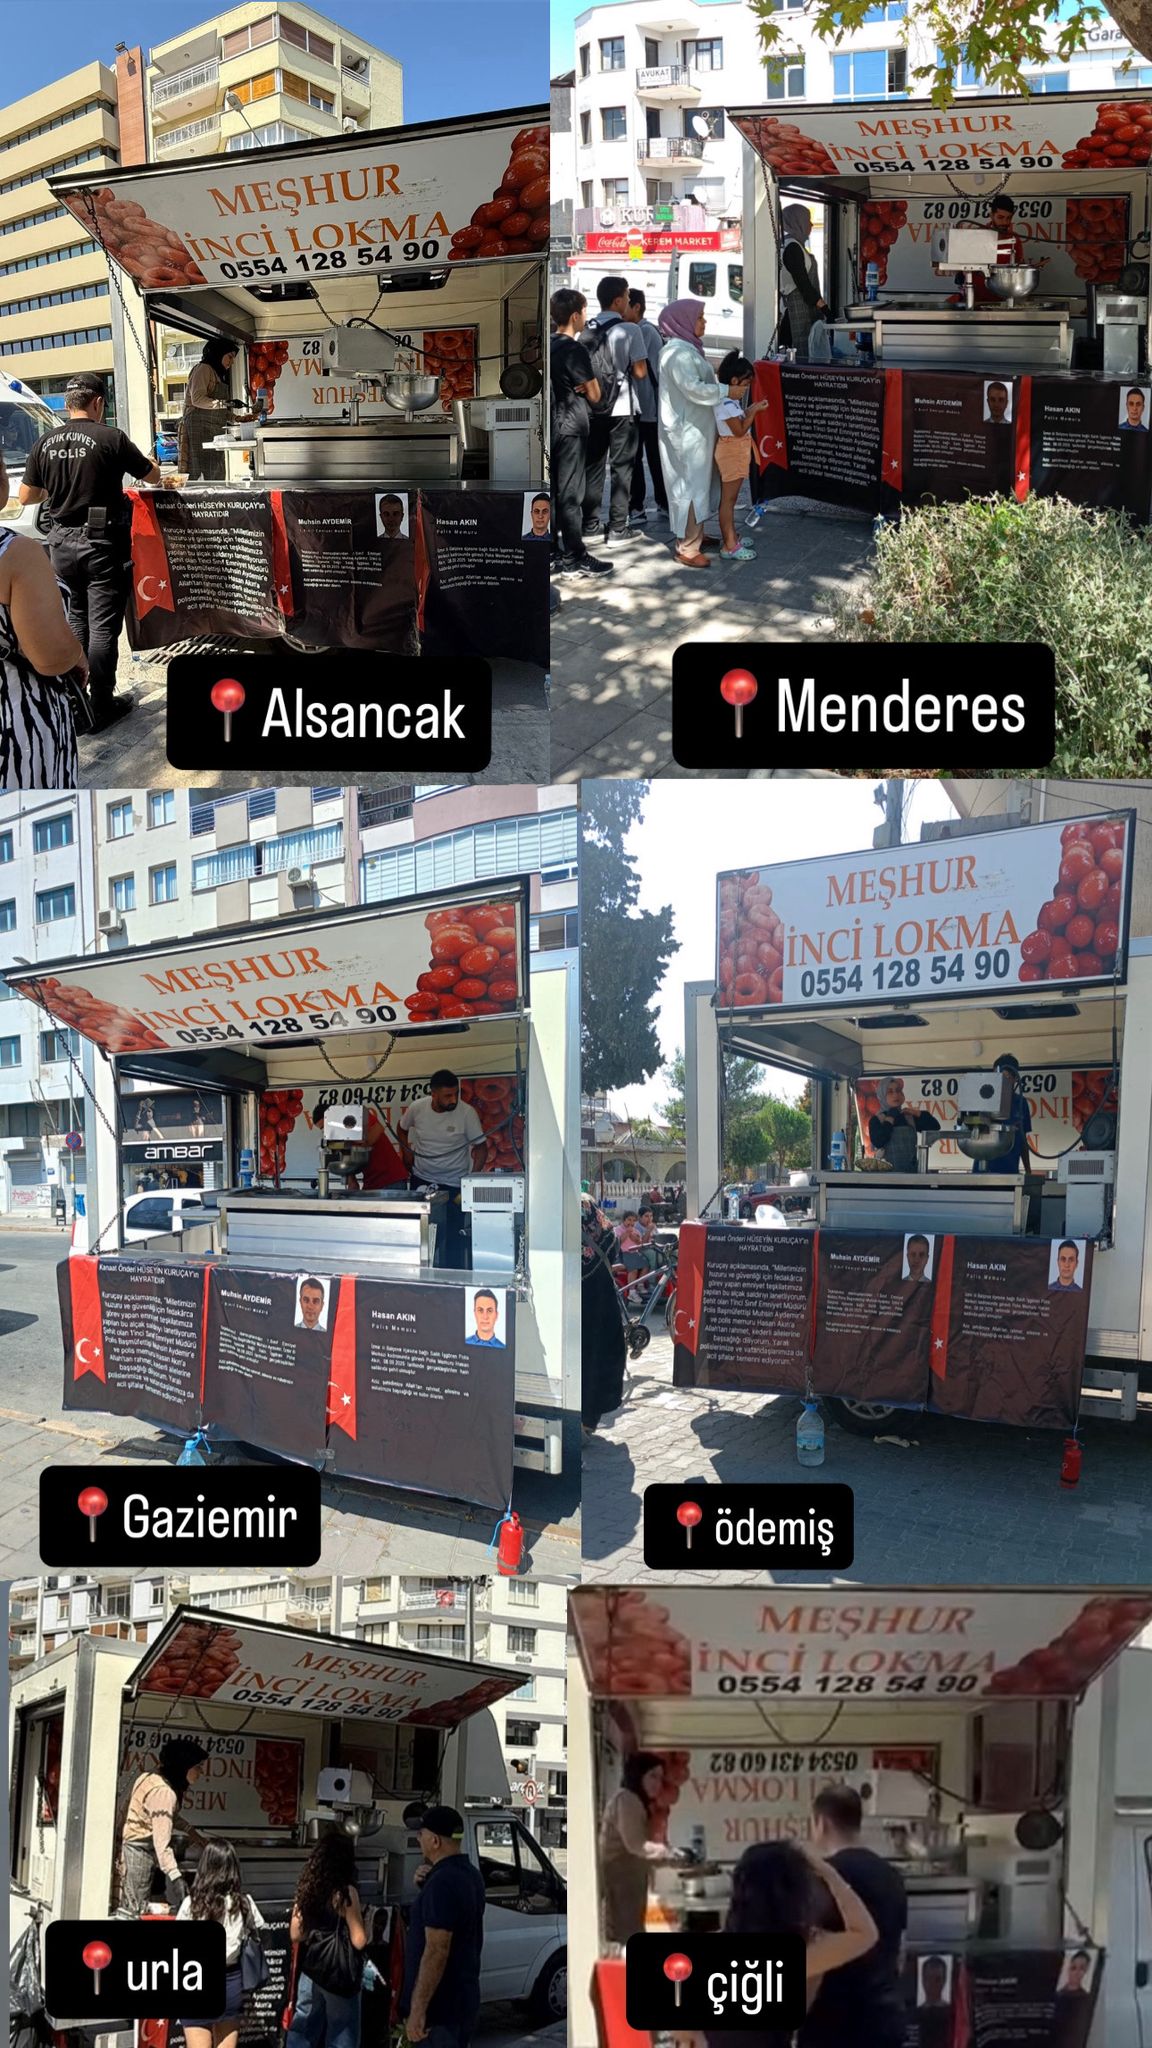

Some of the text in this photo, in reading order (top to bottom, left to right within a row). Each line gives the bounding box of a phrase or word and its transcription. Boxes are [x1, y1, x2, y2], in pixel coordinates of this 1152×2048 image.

[641, 68, 669, 78] AVUKAT
[855, 114, 1016, 138] MEŞHUR
[828, 140, 1062, 161] İNCİ LOKMA
[854, 156, 1052, 172] 0554 128 54 90
[207, 164, 404, 216] MEŞHUR
[184, 211, 452, 262] İNCİ LOKMA
[642, 238, 672, 246] KEREM
[675, 237, 714, 246] MARKET
[220, 240, 440, 280] 0554 128 54 90
[66, 432, 96, 450] KUVVET
[826, 855, 978, 910] MEŞHUR
[786, 909, 1021, 968] İNCİ LOKMA
[140, 946, 332, 996] MEŞHUR
[801, 948, 1010, 998] 0554 128 54 90
[132, 981, 402, 1030] İNCİ LOKMA
[176, 1004, 397, 1044] 0554 128 54 90
[319, 1090, 338, 1106] 82
[830, 1253, 880, 1263] Muhsin AYDEMİR
[967, 1262, 987, 1270] Hasan
[221, 1289, 272, 1305] Muhsin AYDEMİR
[372, 1310, 416, 1322] Hasan AKIN
[758, 1605, 974, 1641] MEŞHUR
[293, 1651, 426, 1688] MEŞHUR
[698, 1642, 996, 1674] İNCİ LOKMA
[228, 1666, 422, 1710] İNCİ LOKMA
[718, 1674, 978, 1694] 0554 128 54 90
[233, 1689, 403, 1720] 0554 128 54 90
[710, 1751, 859, 1774] 82 60 431 0534
[692, 1776, 800, 1804] LOKMA
